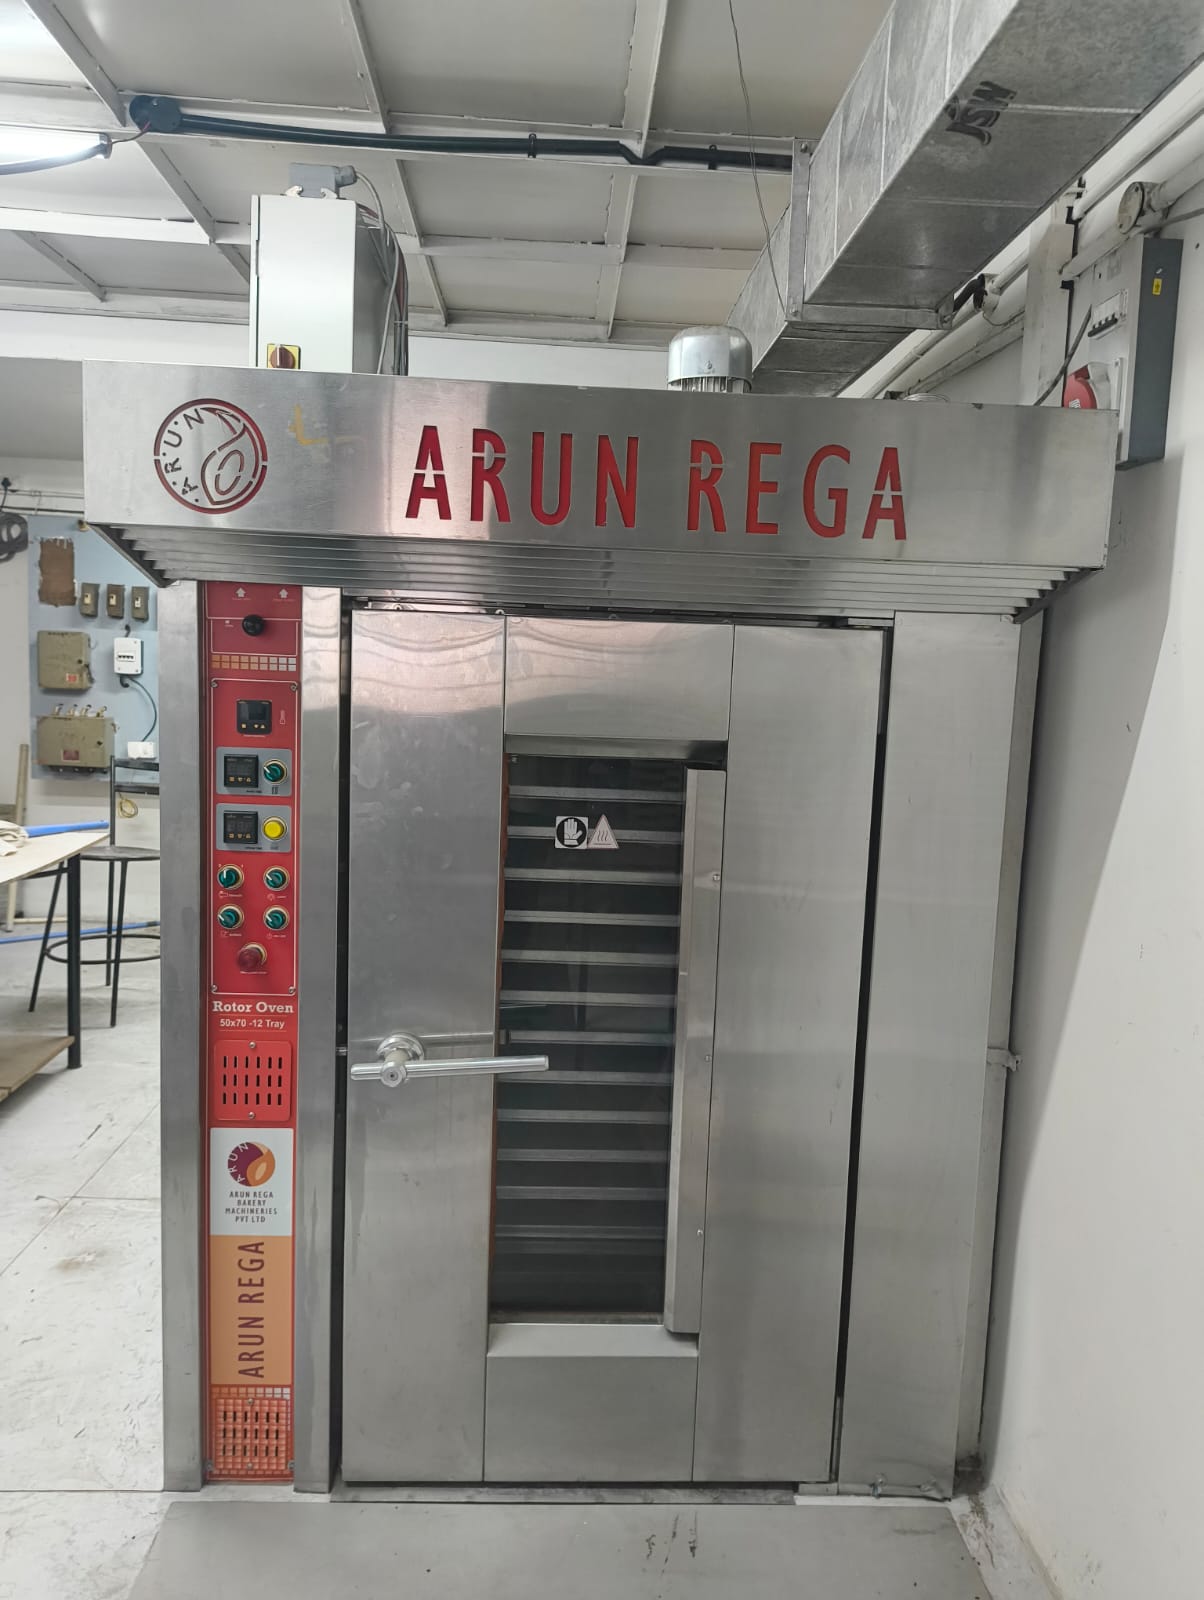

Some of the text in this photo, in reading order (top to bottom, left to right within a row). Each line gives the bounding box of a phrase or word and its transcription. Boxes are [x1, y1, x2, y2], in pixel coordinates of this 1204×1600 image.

[945, 81, 1017, 146] JSW
[405, 425, 907, 541] ARUN REGA
[212, 1001, 294, 1013] Rotor Oven
[220, 1018, 247, 1027] 50x70
[265, 1019, 285, 1029] Tray
[238, 1241, 265, 1378] ARUN REGA
